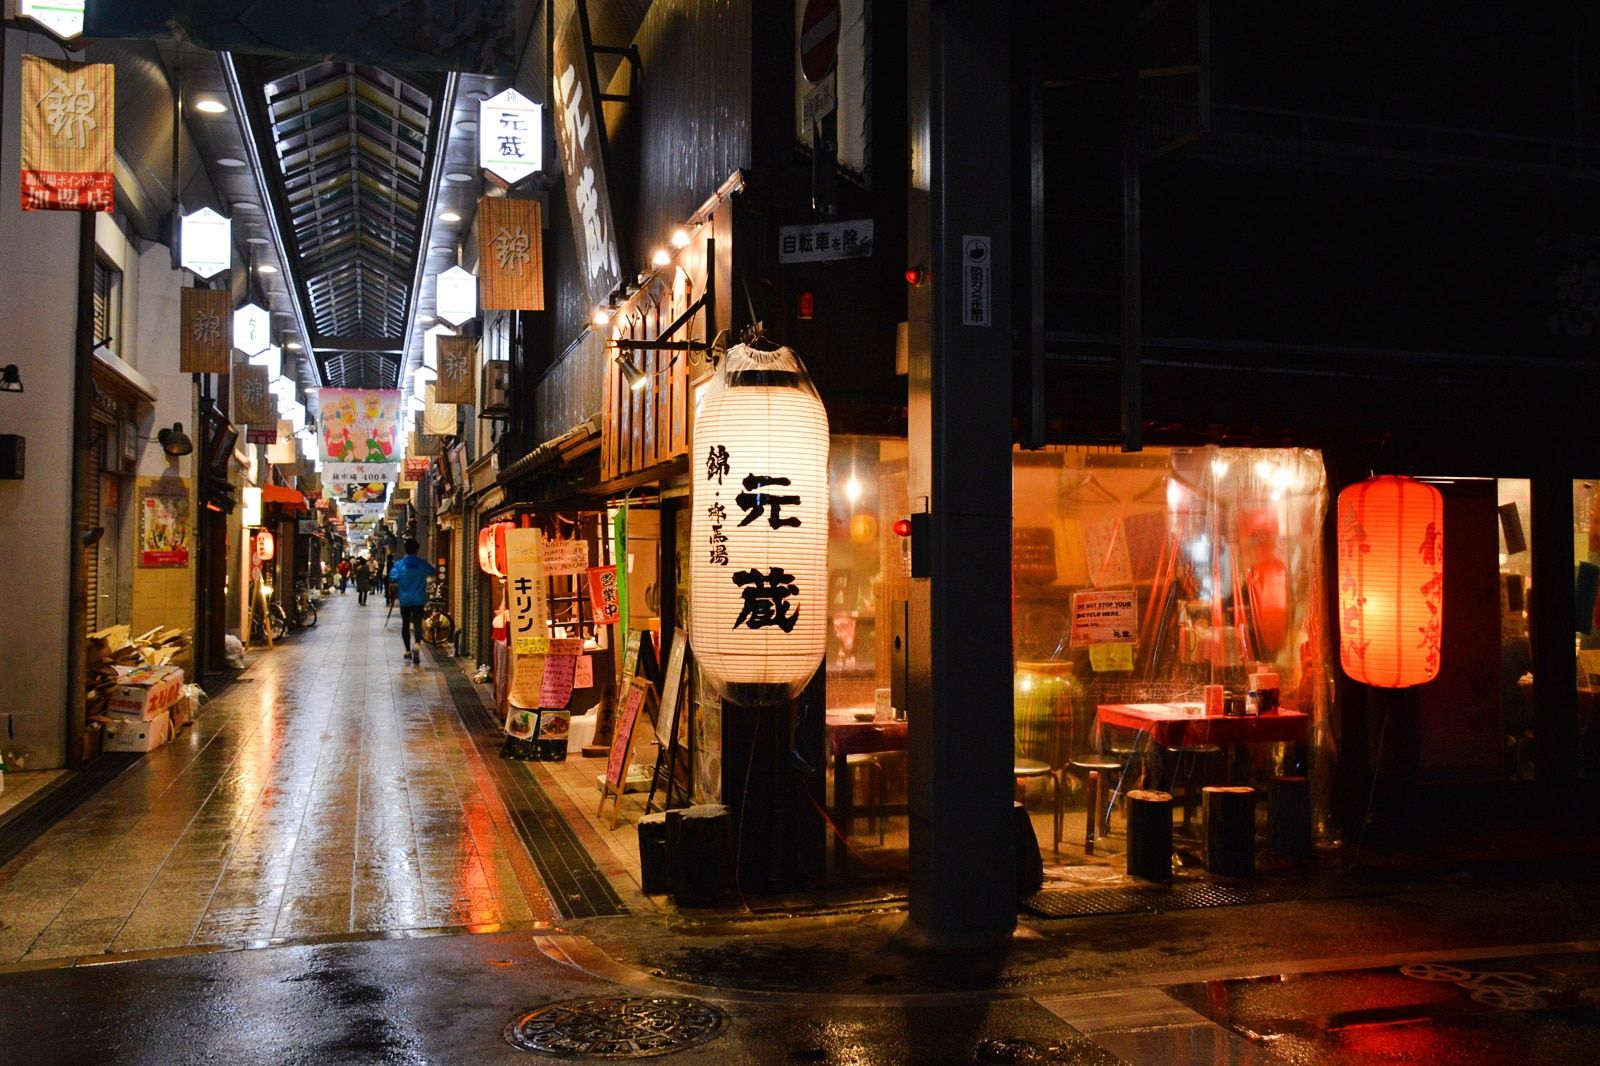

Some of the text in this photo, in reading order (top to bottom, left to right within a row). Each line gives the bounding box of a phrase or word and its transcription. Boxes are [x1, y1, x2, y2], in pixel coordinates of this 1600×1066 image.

[35, 76, 97, 149] 錦
[497, 112, 529, 158] 元蔵
[561, 64, 617, 278] 元蔵
[27, 187, 110, 211] 加盟店
[488, 225, 531, 278] 錦
[783, 229, 869, 254] 自転車を除く
[732, 473, 802, 634] 元蔵
[514, 577, 533, 632] キリン
[601, 572, 618, 617] 営業中
